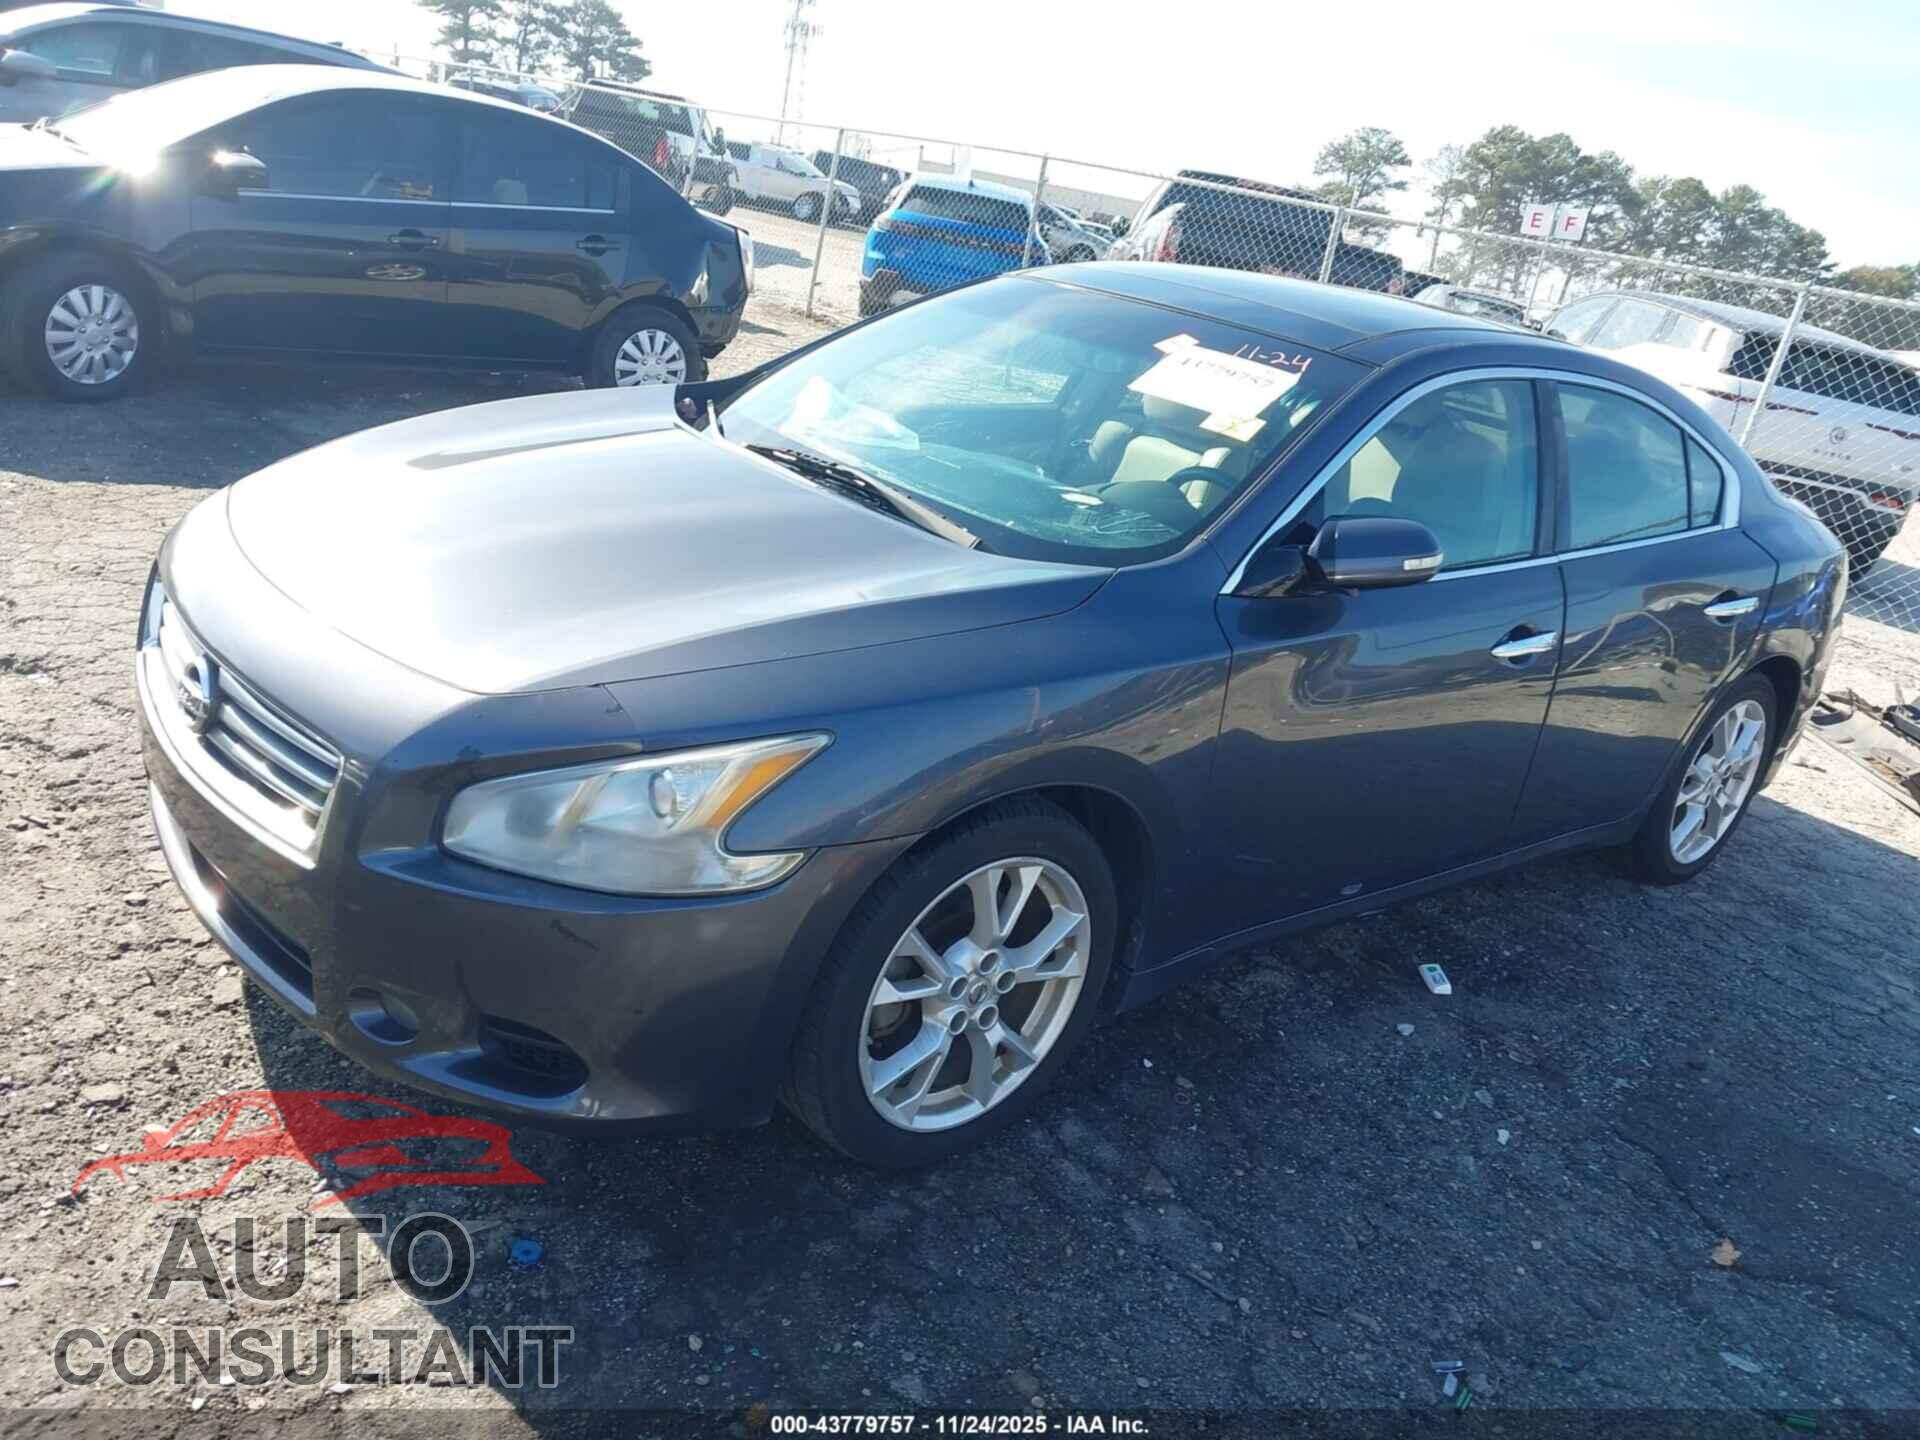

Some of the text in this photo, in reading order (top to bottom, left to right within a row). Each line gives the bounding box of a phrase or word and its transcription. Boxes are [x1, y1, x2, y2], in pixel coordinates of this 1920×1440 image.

[1530, 212, 1544, 228] E
[1564, 216, 1578, 232] F
[1232, 343, 1313, 372] 11-24
